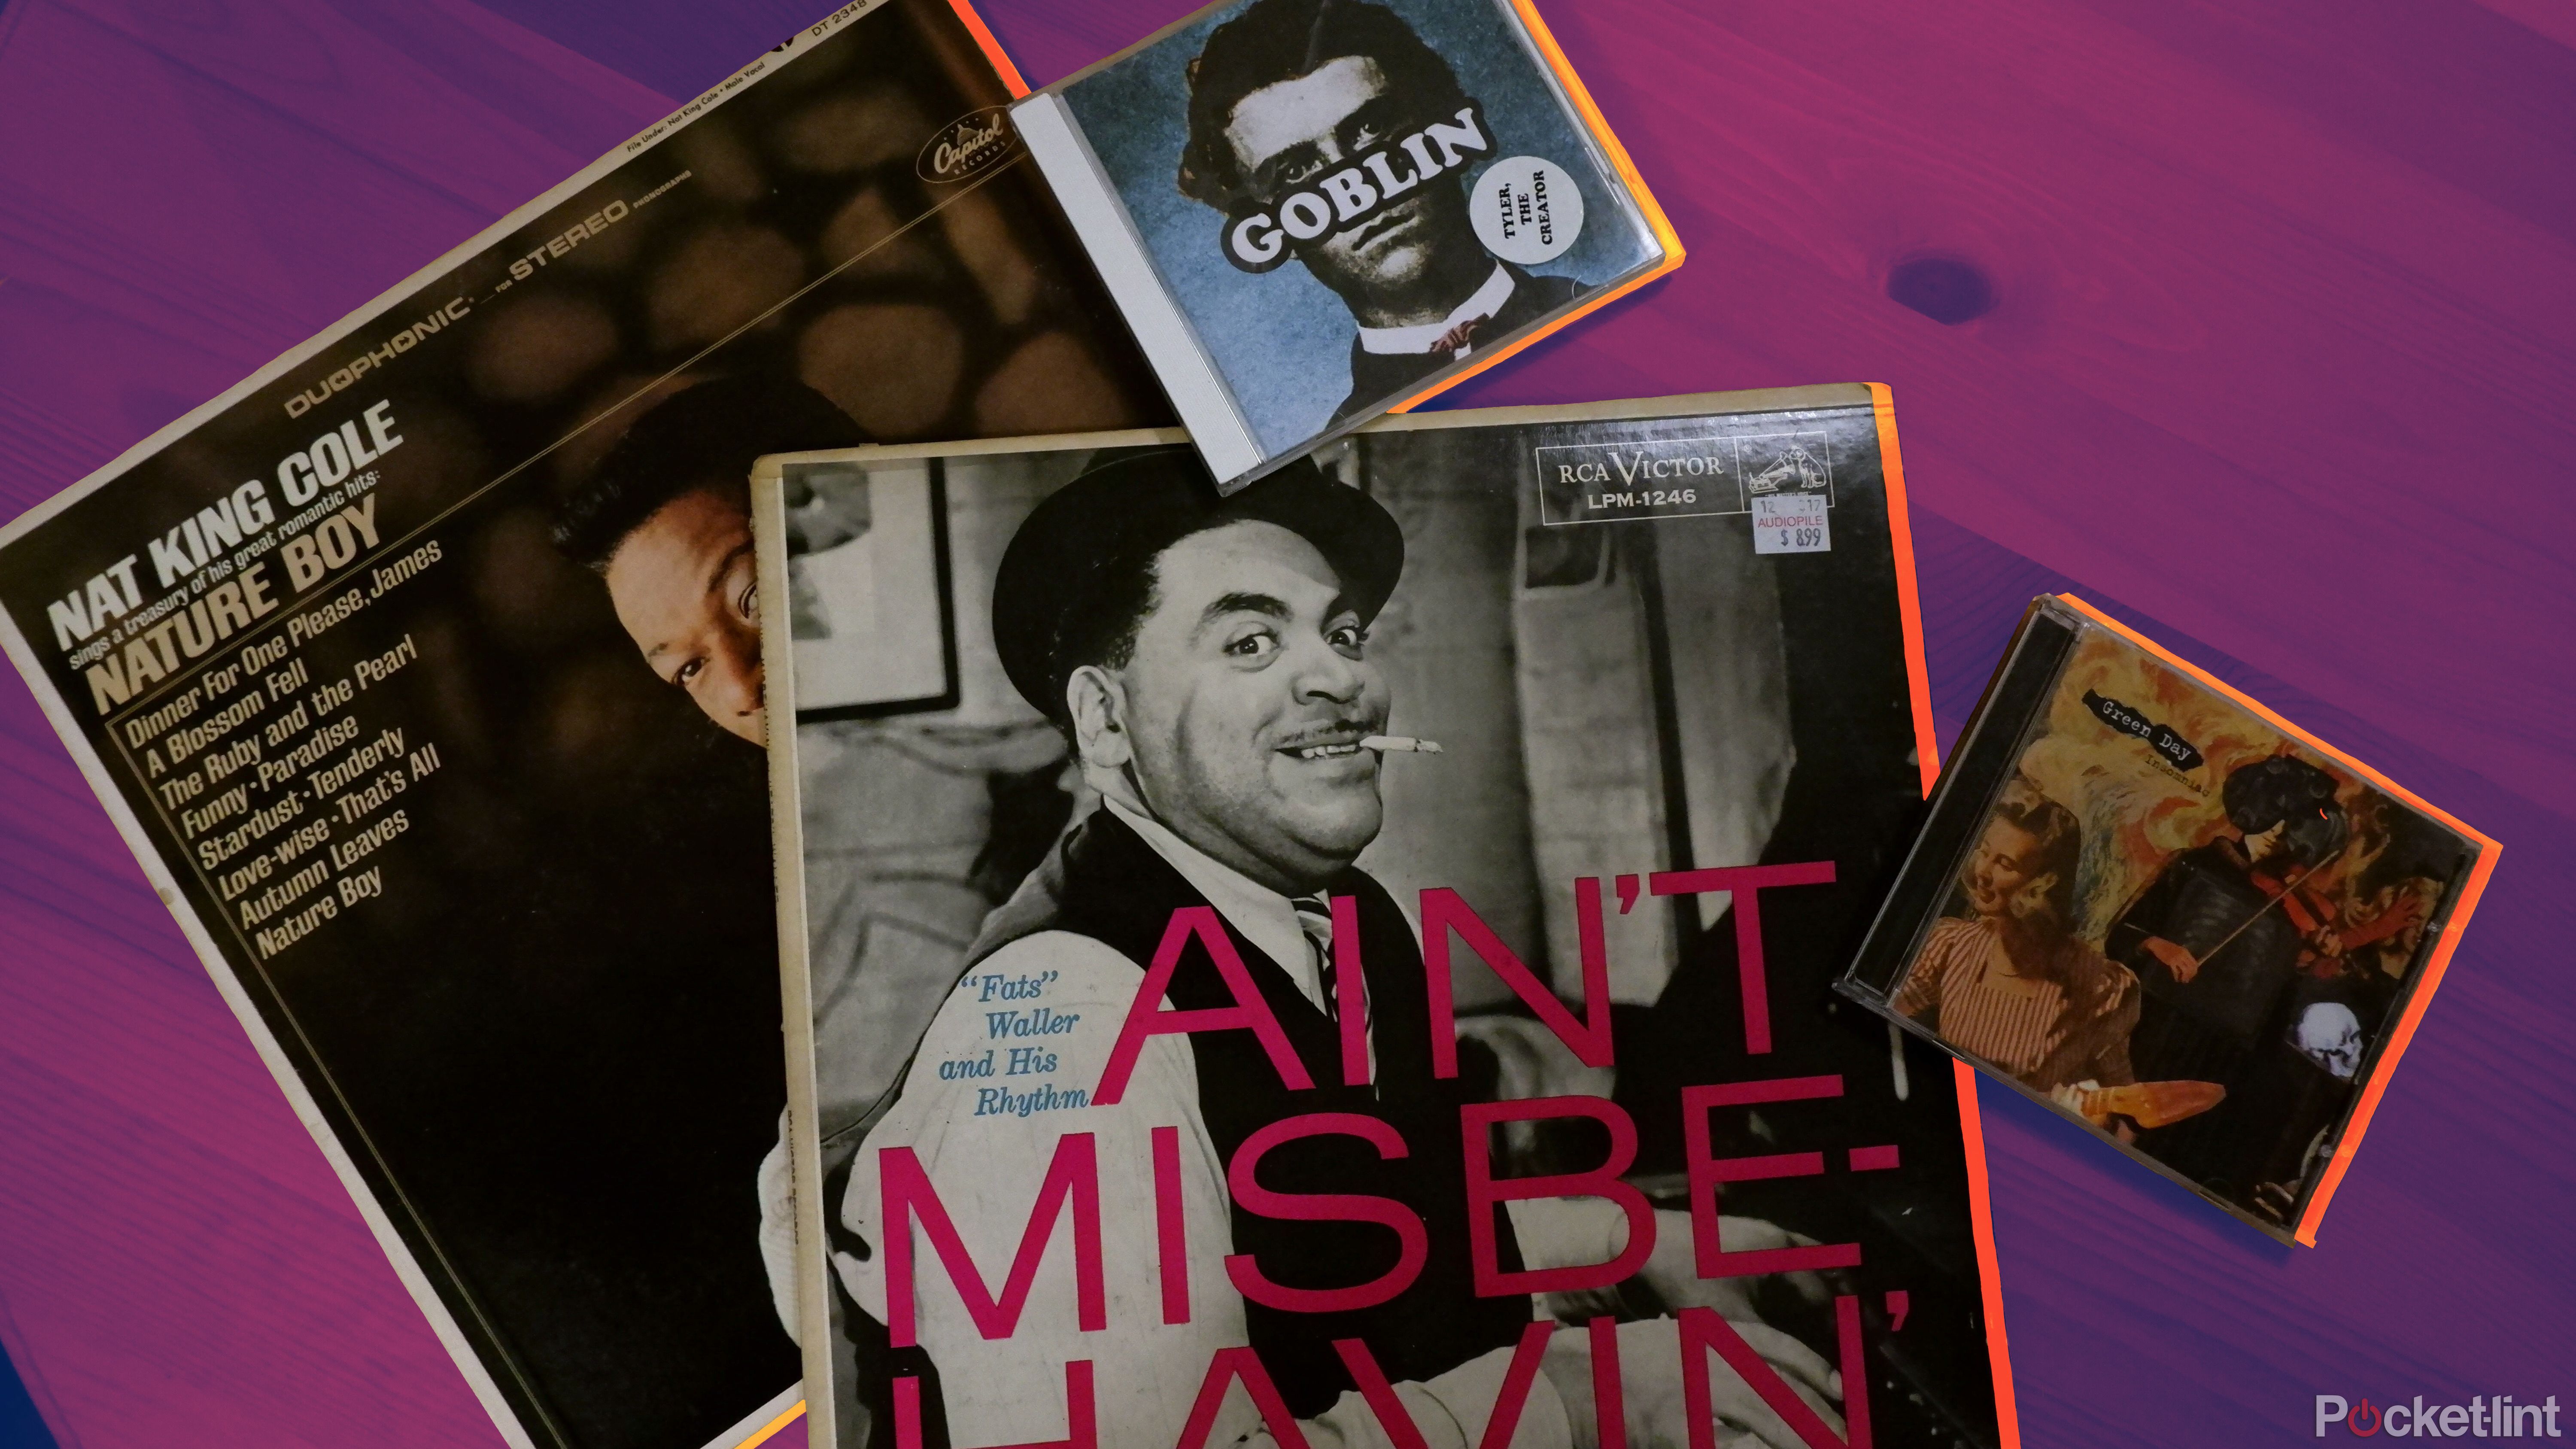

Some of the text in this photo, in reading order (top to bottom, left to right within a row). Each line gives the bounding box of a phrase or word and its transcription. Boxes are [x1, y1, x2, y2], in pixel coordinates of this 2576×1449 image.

[811, 0, 867, 36] DT 2348
[627, 141, 641, 152] File
[668, 114, 682, 126] Nat
[683, 103, 702, 117] King
[702, 92, 719, 105] Cole
[725, 77, 743, 91] Male
[744, 62, 765, 77] Vocal
[934, 113, 1003, 174] Capitol
[1232, 107, 1488, 264] GOBLIN
[1499, 183, 1515, 239] TYLER,
[1518, 193, 1532, 225] THE
[1533, 170, 1553, 245] CREATOR
[283, 169, 692, 419] DUOPHONIC FOR STEREO PHONOGRAPHS
[1559, 451, 1724, 486] RCA VICTOR
[1588, 489, 1696, 510] LPM-1246
[47, 398, 404, 652] NAT KING COLE
[1758, 516, 1823, 528] AUDIOPILE
[1781, 529, 1788, 547] $
[69, 469, 381, 671] sings a treasury of his great romantic hits:
[84, 492, 381, 716] NATURE BOY
[125, 538, 443, 749] Dinner For One Please, James
[146, 658, 309, 778] A Blossom Fell
[159, 634, 417, 810] The Ruby and the Pearl
[2103, 700, 2191, 761] Green Day
[2145, 753, 2210, 797] Insomniac
[219, 818, 329, 901] Love-wise
[410, 742, 441, 781] All
[240, 807, 410, 930] Autumn Leaves
[256, 864, 384, 960] Nature Boy
[986, 1008, 1080, 1039] Waller
[1091, 860, 1836, 1106] AIN'T
[939, 1046, 1058, 1081] and His
[974, 1084, 1090, 1118] Rhythm
[878, 1073, 1899, 1347] MISBE-
